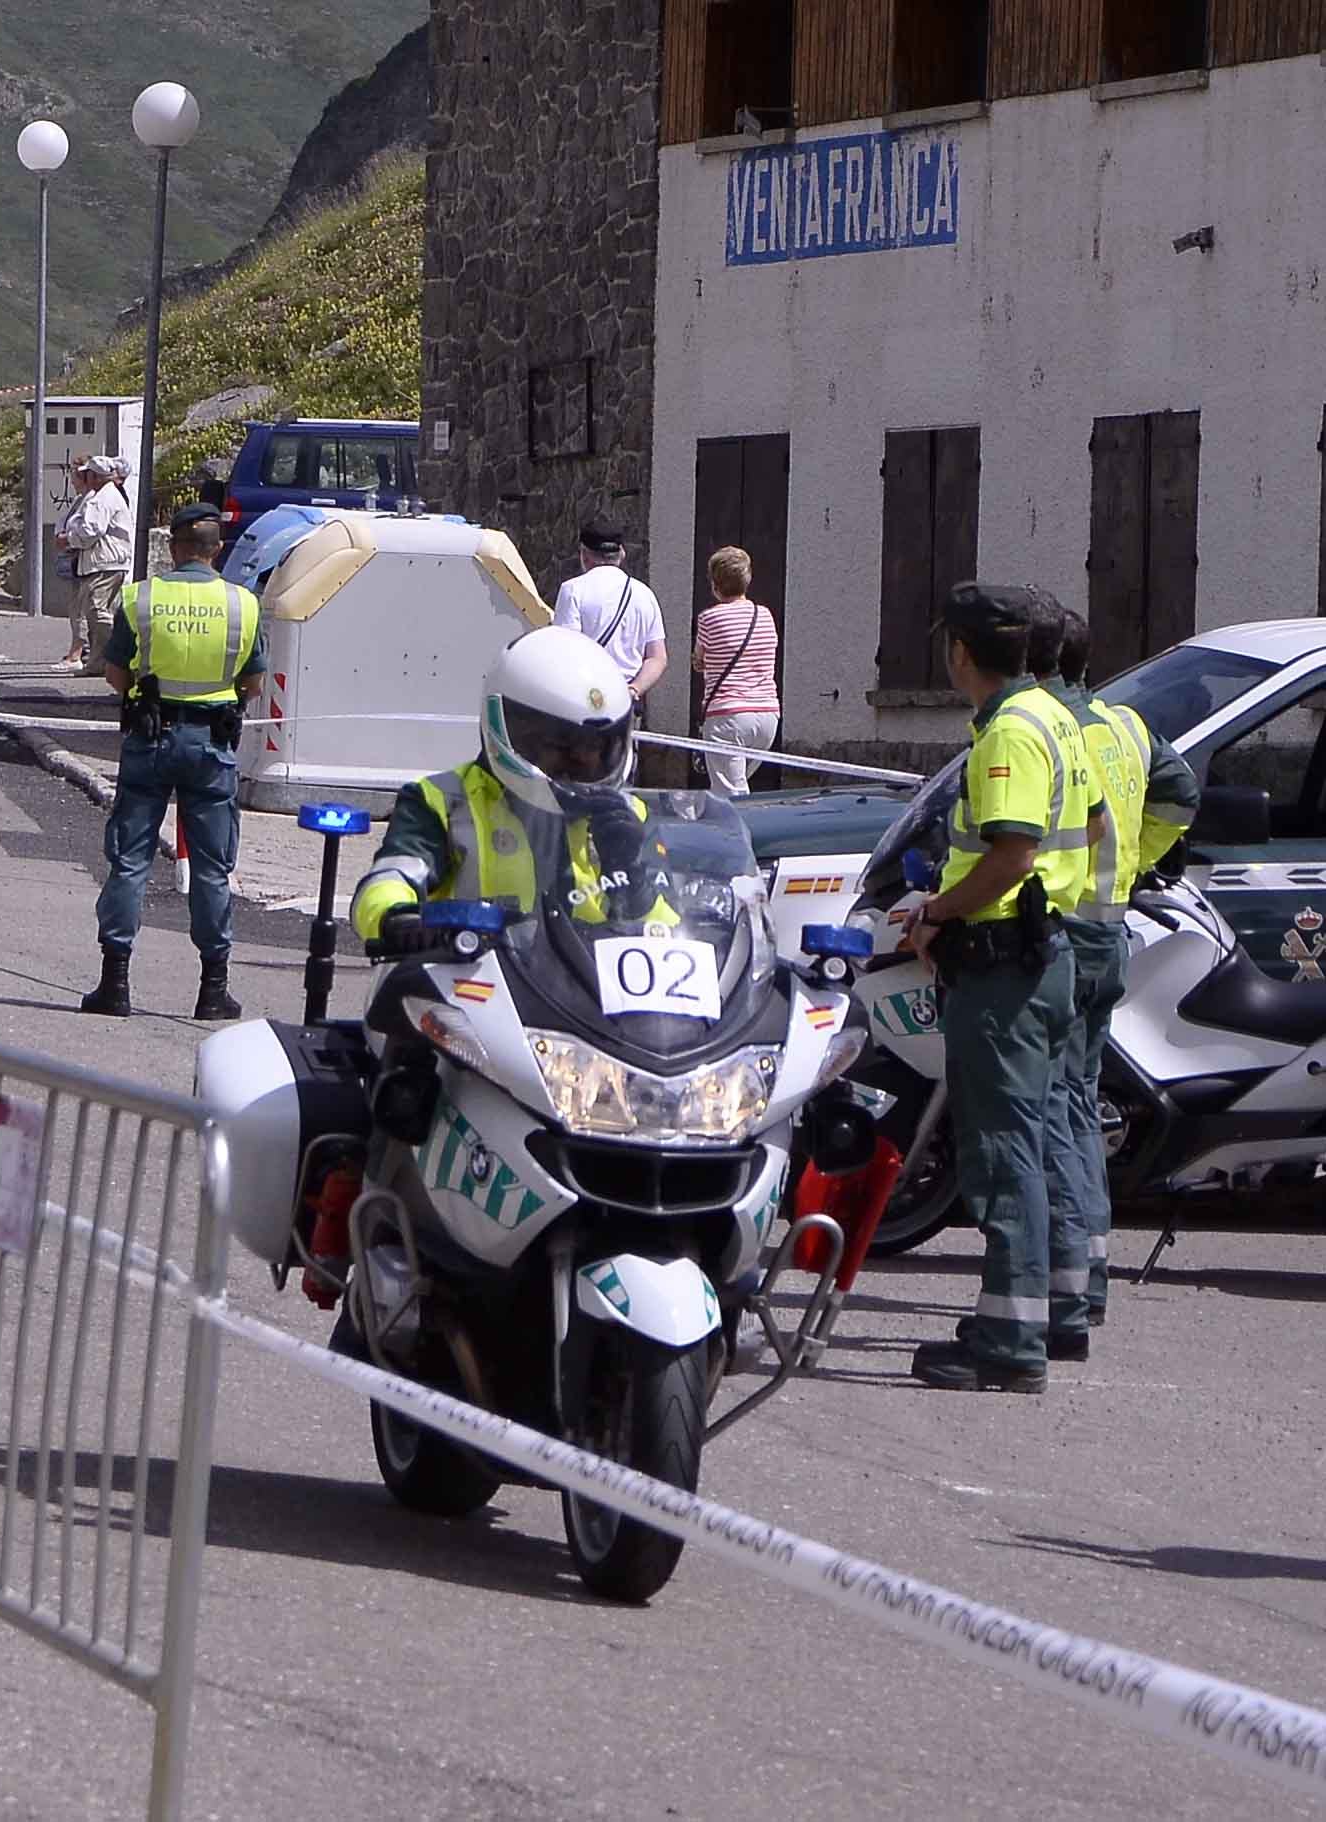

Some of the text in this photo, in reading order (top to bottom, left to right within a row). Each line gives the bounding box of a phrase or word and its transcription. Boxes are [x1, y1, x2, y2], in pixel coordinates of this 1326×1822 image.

[153, 603, 225, 618] GUARDIA
[166, 620, 210, 634] CIVIL
[617, 947, 701, 1001] 02
